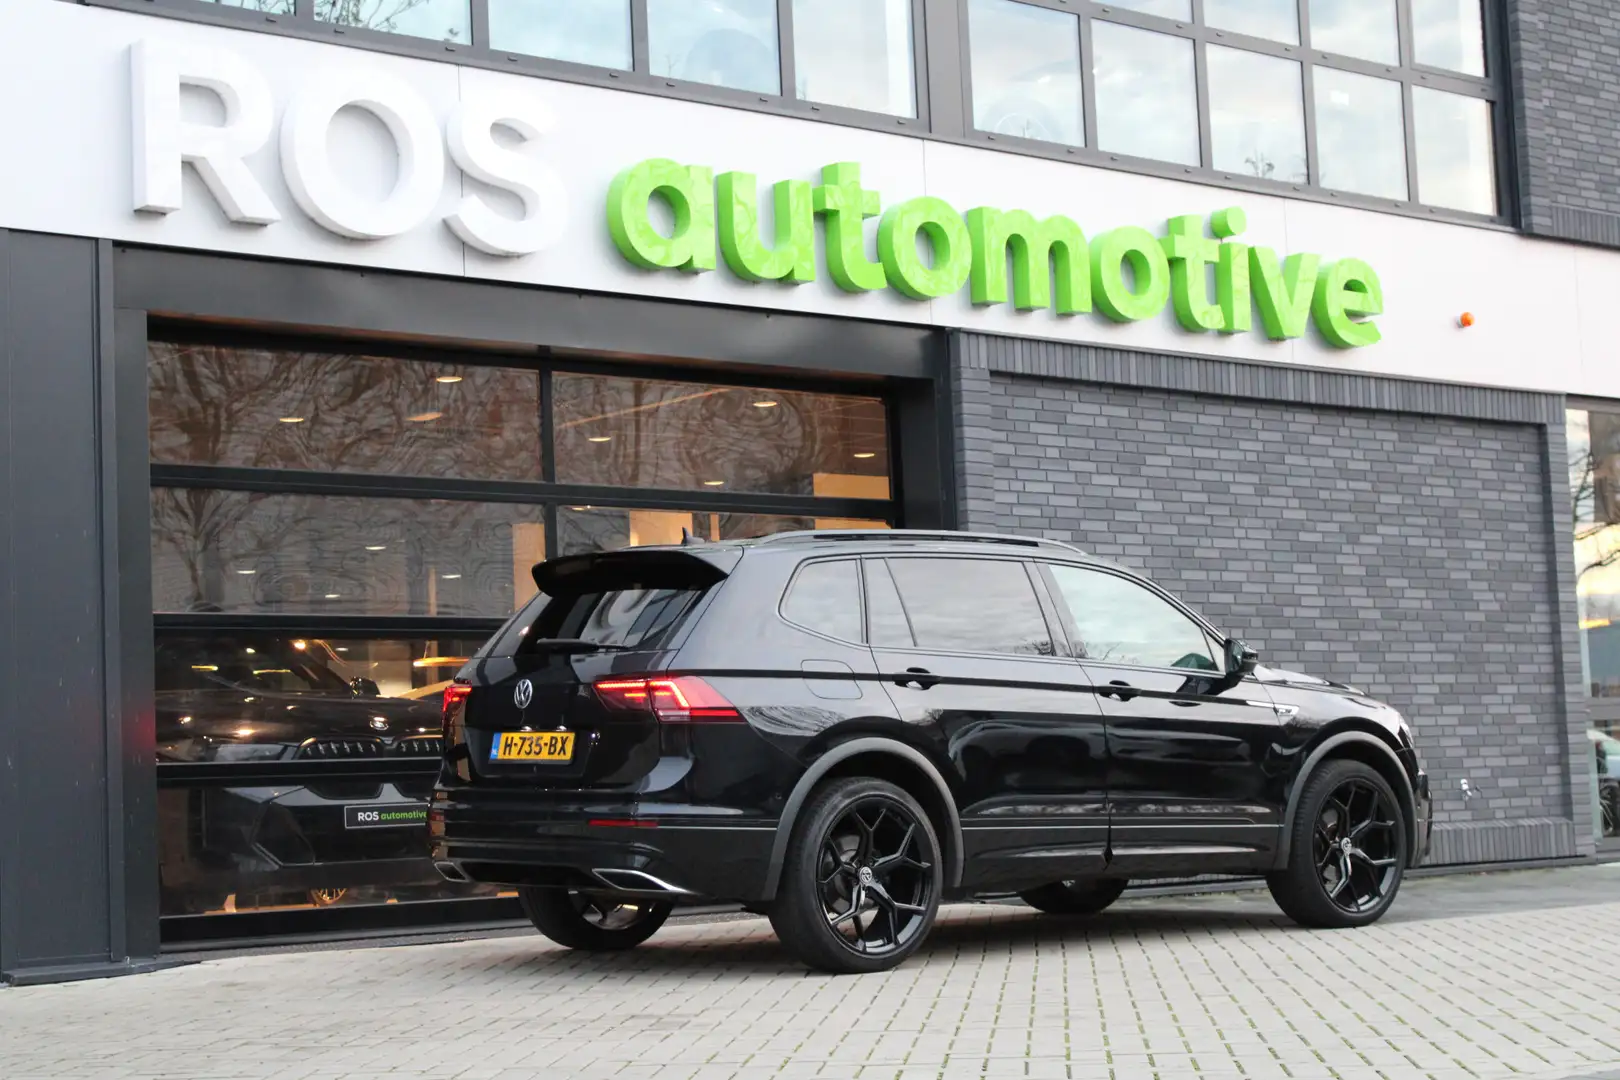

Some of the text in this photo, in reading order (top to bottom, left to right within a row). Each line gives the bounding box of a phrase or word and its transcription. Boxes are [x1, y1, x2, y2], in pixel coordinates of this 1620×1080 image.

[129, 38, 1384, 348] ROS automotive
[503, 736, 569, 756] H-735-BX
[357, 811, 380, 822] ROS
